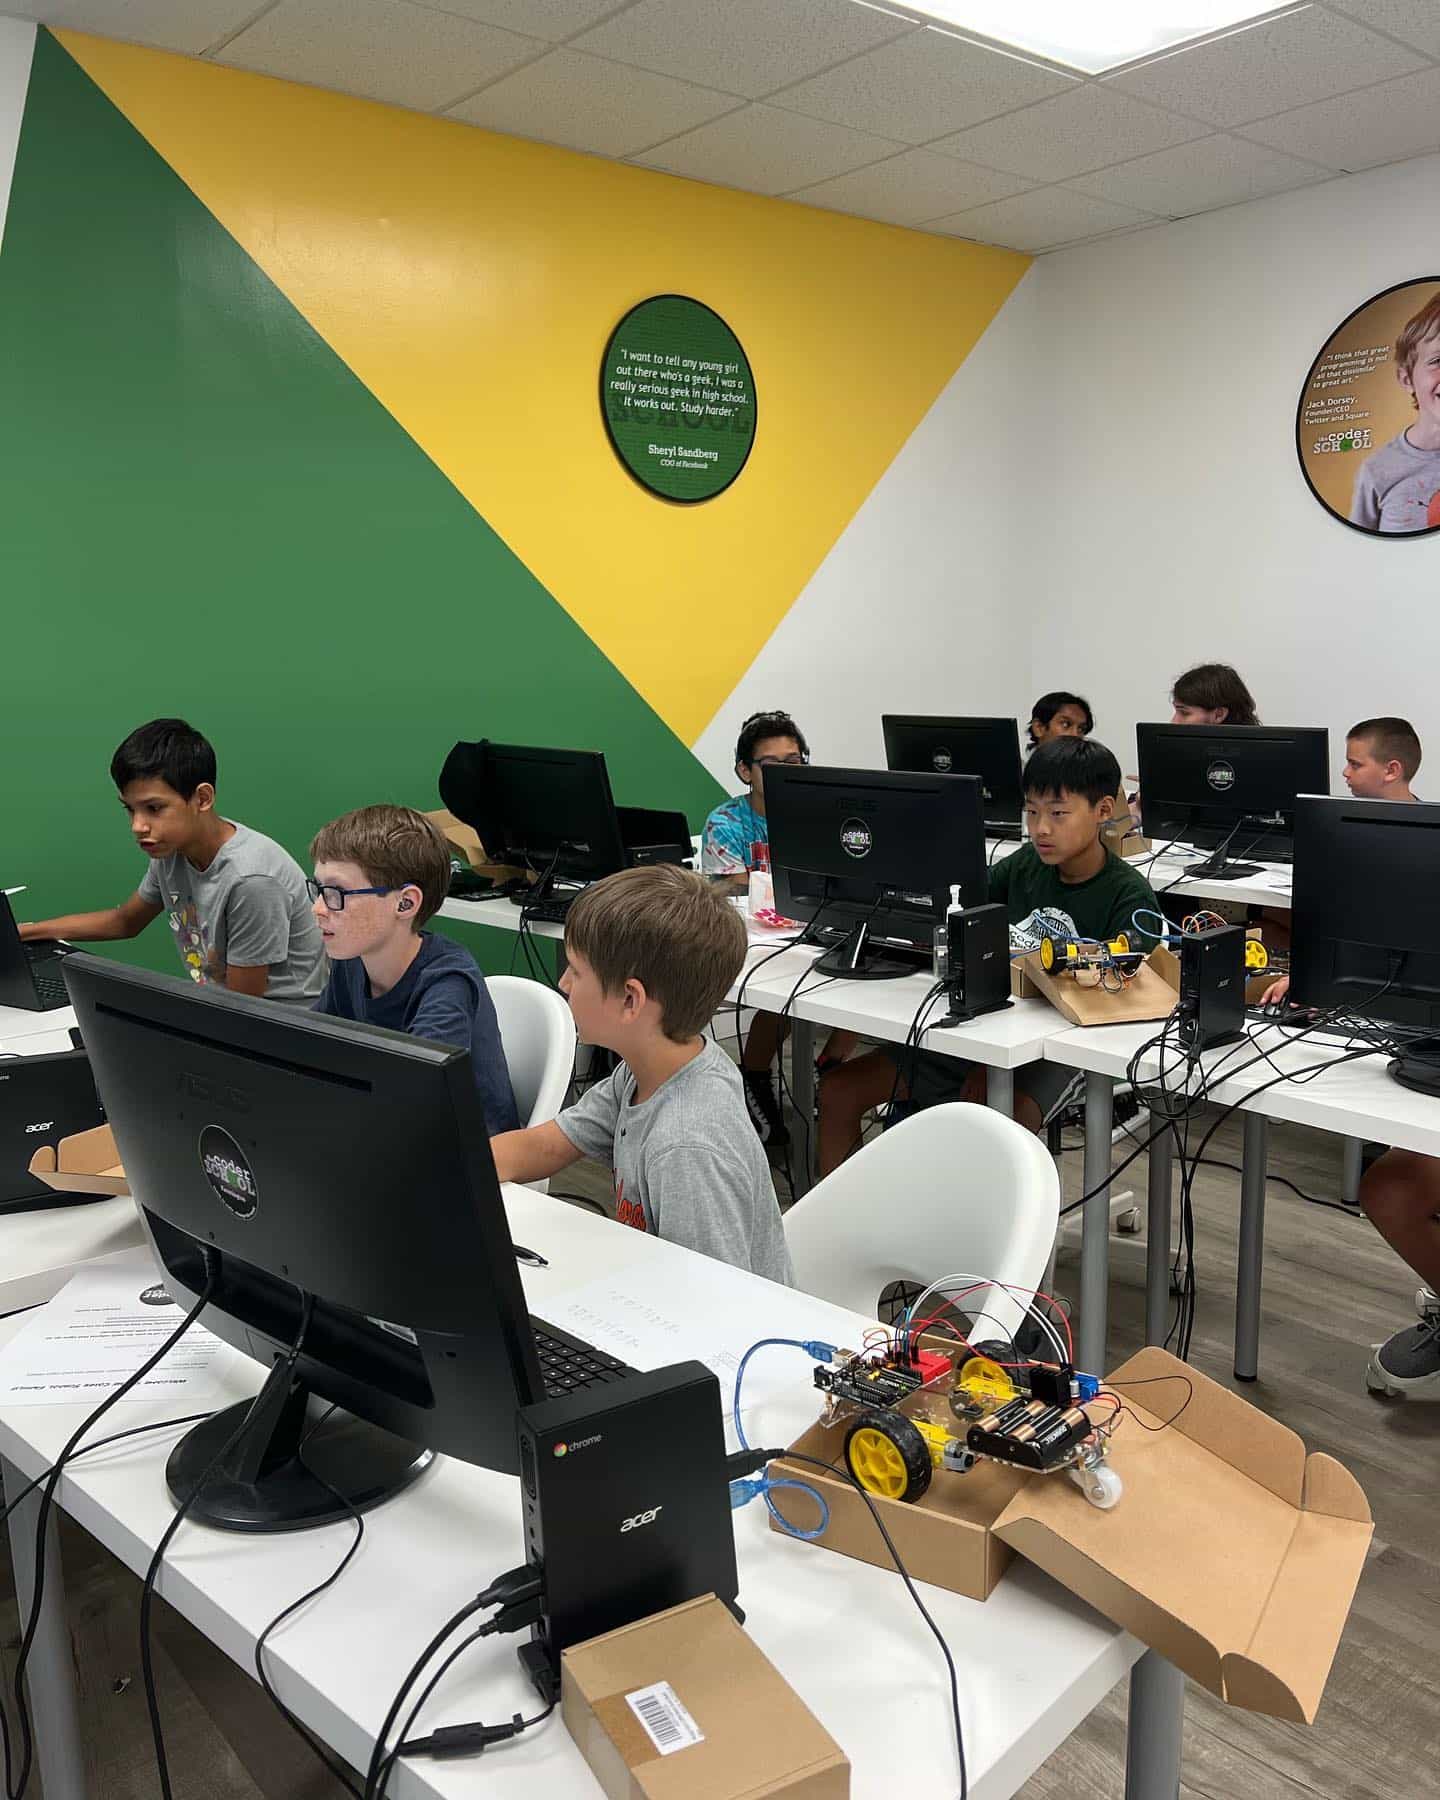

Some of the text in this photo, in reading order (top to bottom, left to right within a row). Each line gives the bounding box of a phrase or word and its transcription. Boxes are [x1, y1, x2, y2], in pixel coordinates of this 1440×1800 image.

[629, 353, 651, 362] want
[653, 354, 663, 364] to
[665, 355, 680, 366] tell
[682, 359, 697, 370] any
[699, 361, 723, 374] young
[725, 363, 738, 375] girl
[616, 366, 631, 376] out
[634, 366, 657, 379] there
[660, 370, 683, 382] who's
[692, 374, 713, 386] geek,
[721, 379, 736, 388] was
[610, 380, 749, 404] really serious geek in high school.
[624, 396, 631, 407] It
[633, 398, 659, 409] works
[661, 401, 678, 411] out.
[681, 402, 704, 416] Study
[1306, 399, 1325, 409] Jack
[1328, 428, 1372, 442] coder
[648, 444, 718, 462] Sheryl Sandberg
[25, 1121, 54, 1133] acer
[568, 1434, 602, 1452] chrome
[620, 1506, 662, 1533] acer
